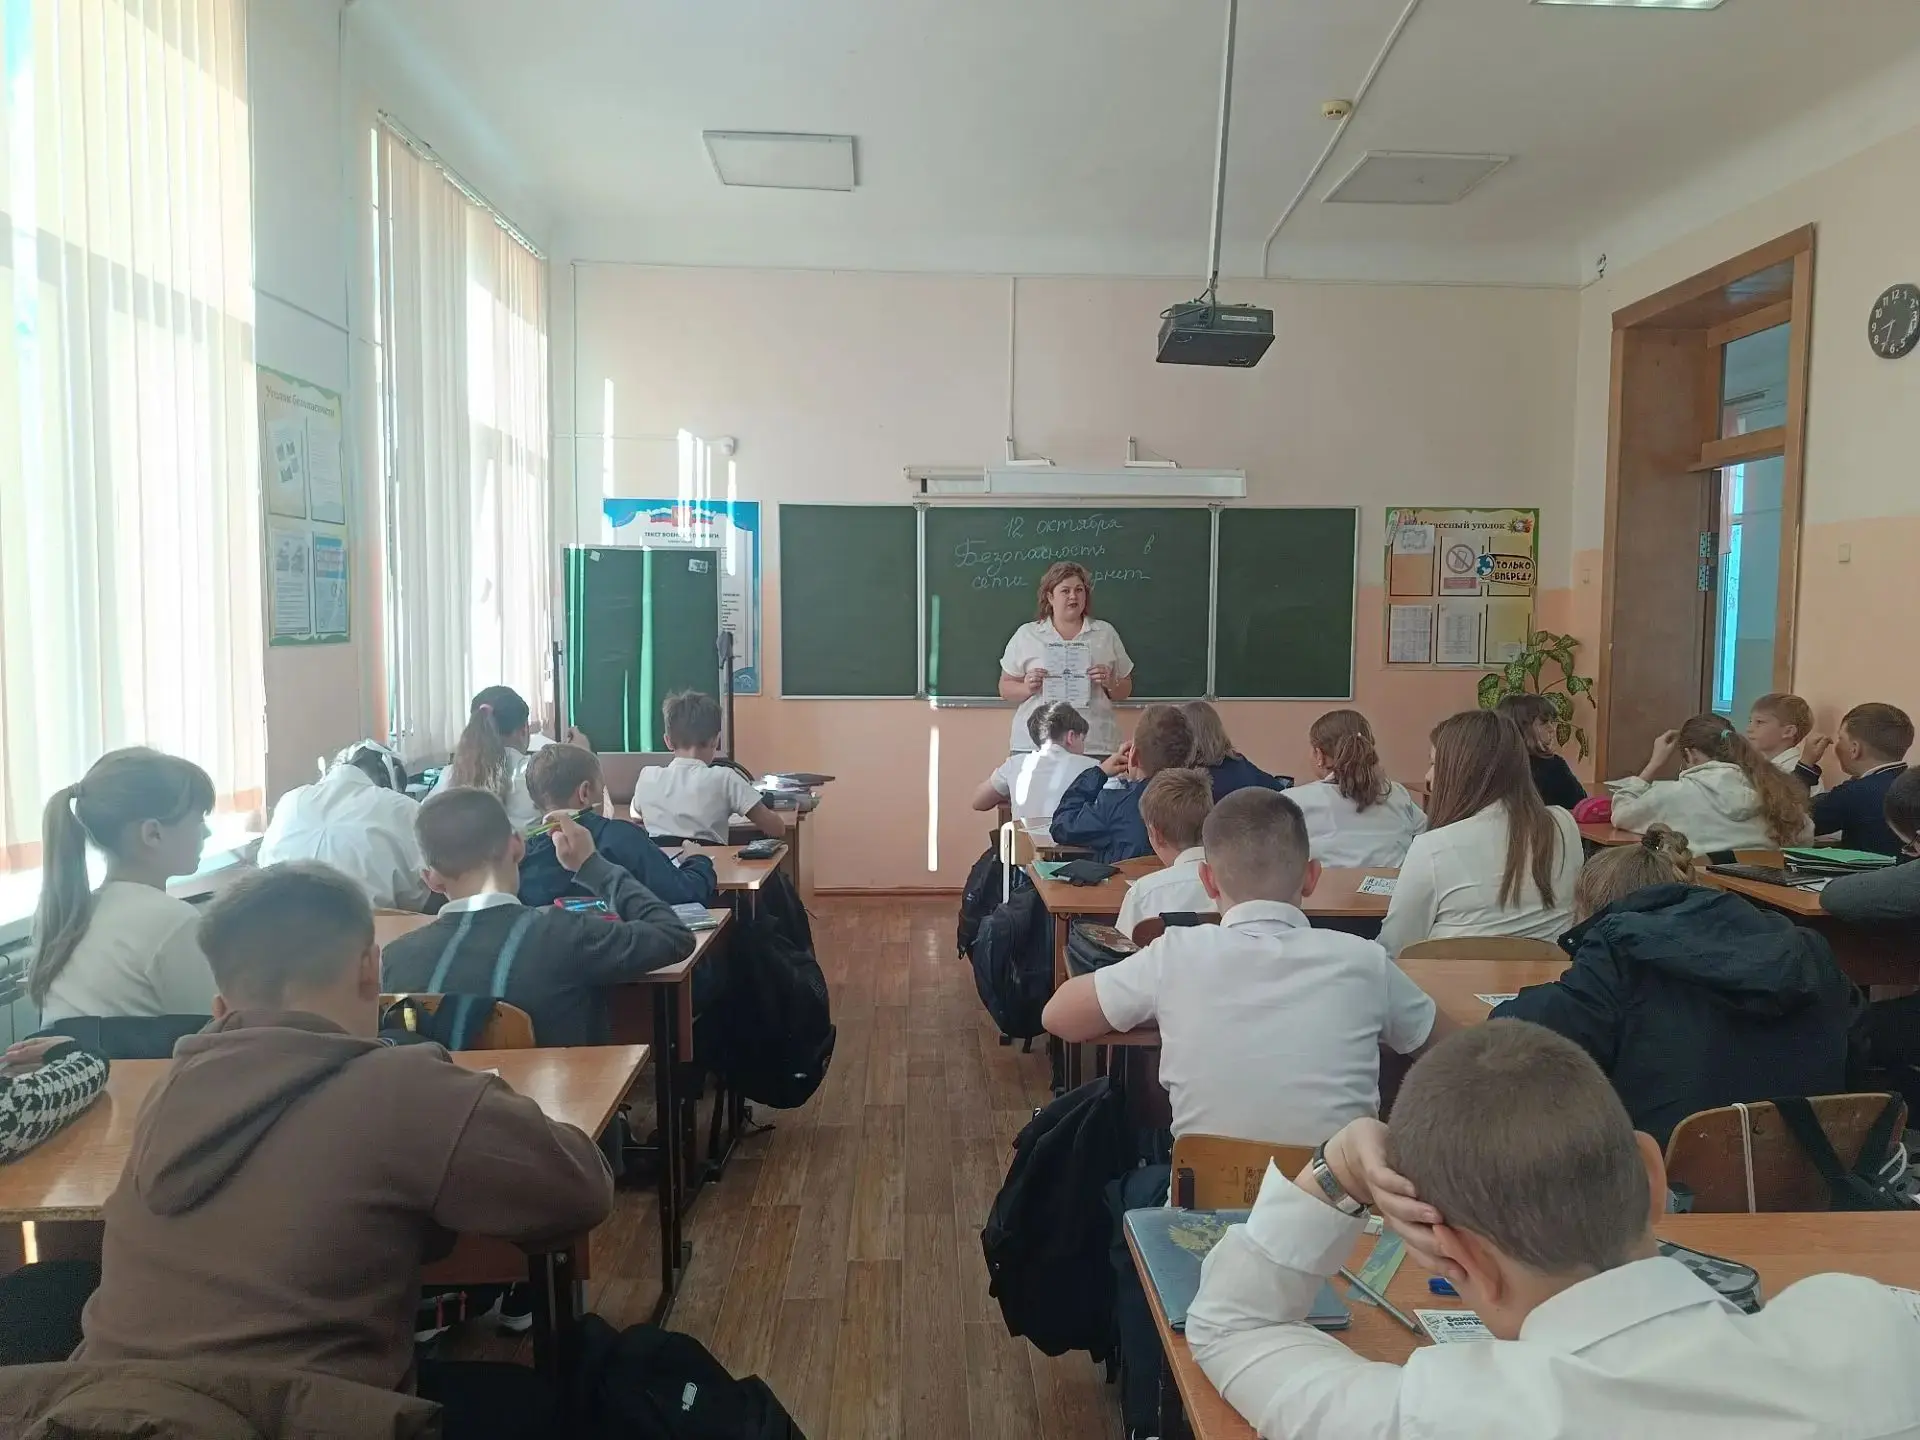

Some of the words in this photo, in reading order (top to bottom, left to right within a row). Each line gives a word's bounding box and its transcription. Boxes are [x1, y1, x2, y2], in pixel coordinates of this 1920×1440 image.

[1892, 290, 1900, 300] 12
[1883, 297, 1888, 306] 11
[1875, 308, 1883, 318] 10
[1872, 323, 1877, 333] 9
[1874, 335, 1879, 345] 8
[1004, 516, 1025, 539] 12
[1036, 513, 1125, 537] октября
[1420, 519, 1470, 529] Кассный
[1471, 522, 1506, 531] уголок
[954, 537, 1106, 577] Безопасность
[1143, 533, 1156, 555] в
[1496, 560, 1531, 570] ТОЛЬКО
[971, 572, 1029, 591] сети
[1091, 569, 1151, 591] рнет
